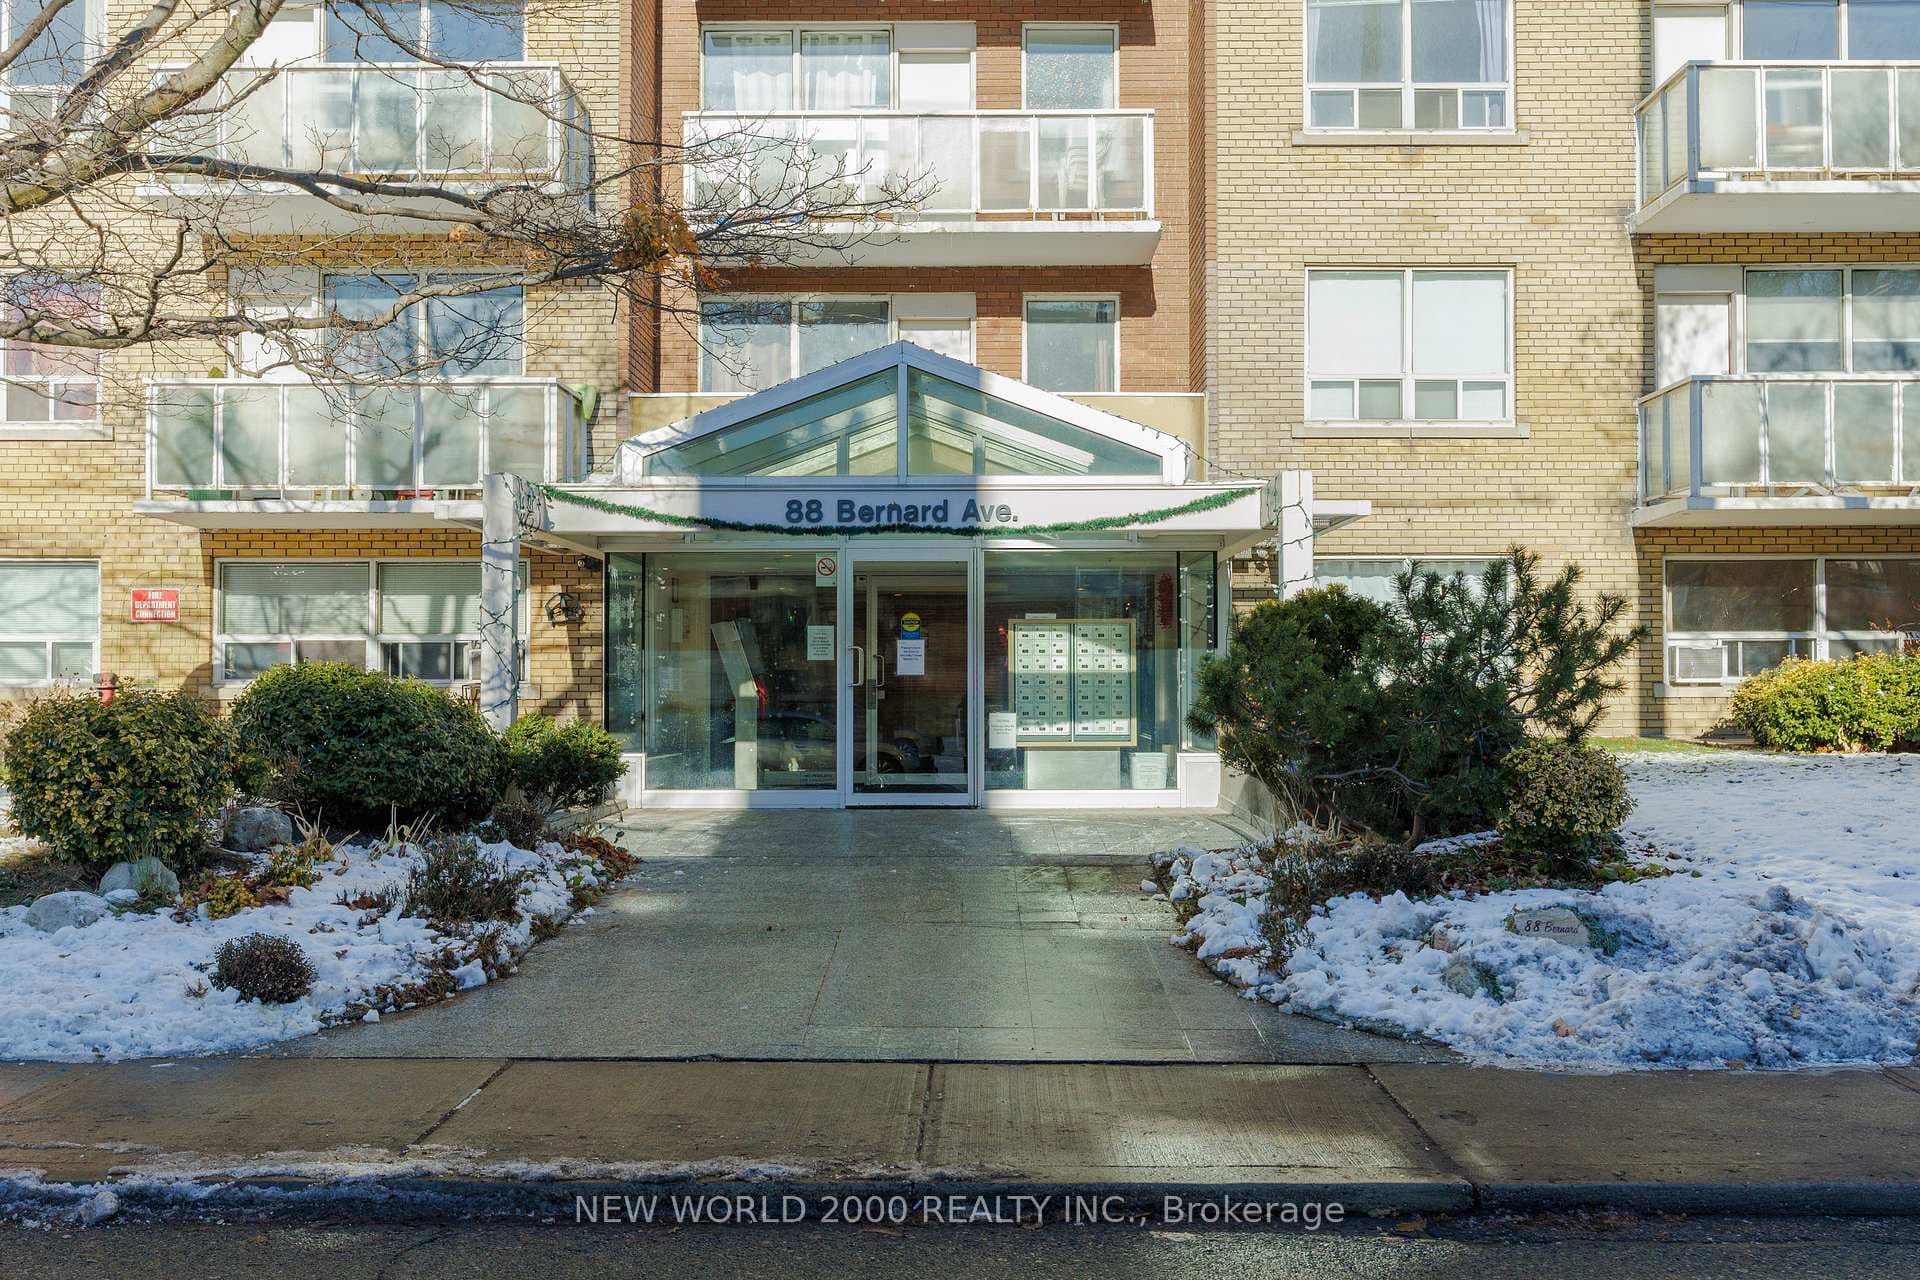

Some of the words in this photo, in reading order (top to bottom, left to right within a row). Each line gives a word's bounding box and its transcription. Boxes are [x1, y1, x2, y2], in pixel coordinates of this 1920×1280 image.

[785, 499, 824, 524] 88
[837, 498, 949, 524] Bernard
[961, 498, 1019, 523] Ave.
[148, 591, 163, 600] FIRE
[134, 600, 177, 609] DEPARTMENT
[135, 609, 177, 618] CONNECTION
[1524, 919, 1541, 933] 88
[1543, 920, 1579, 935] Bernard
